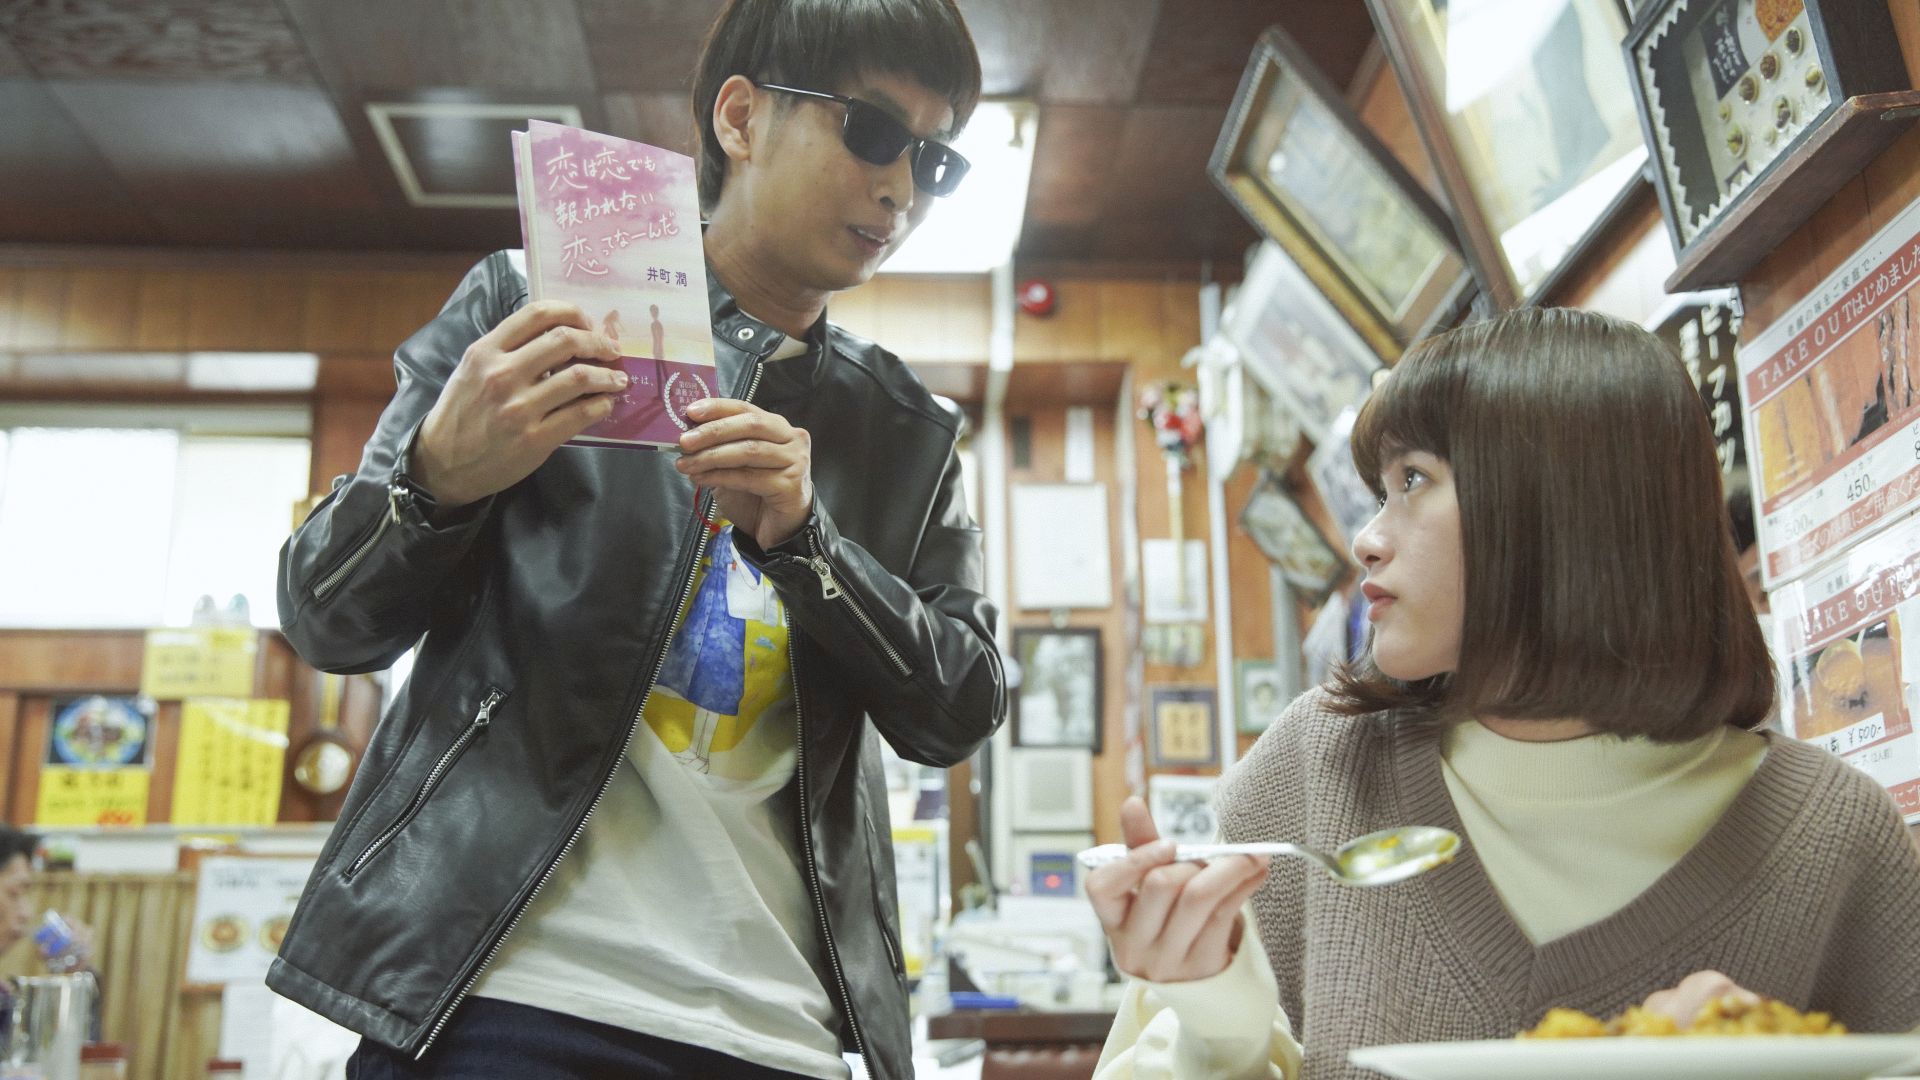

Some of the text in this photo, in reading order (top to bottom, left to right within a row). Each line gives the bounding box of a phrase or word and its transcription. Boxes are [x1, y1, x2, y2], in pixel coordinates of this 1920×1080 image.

[546, 146, 657, 191] 恋は恋でも
[555, 190, 654, 230] 報われない
[561, 210, 679, 278] 恋ってなーんだ
[646, 266, 671, 284] 井町
[1757, 338, 1810, 391] TAKE
[1803, 600, 1849, 637] AKE
